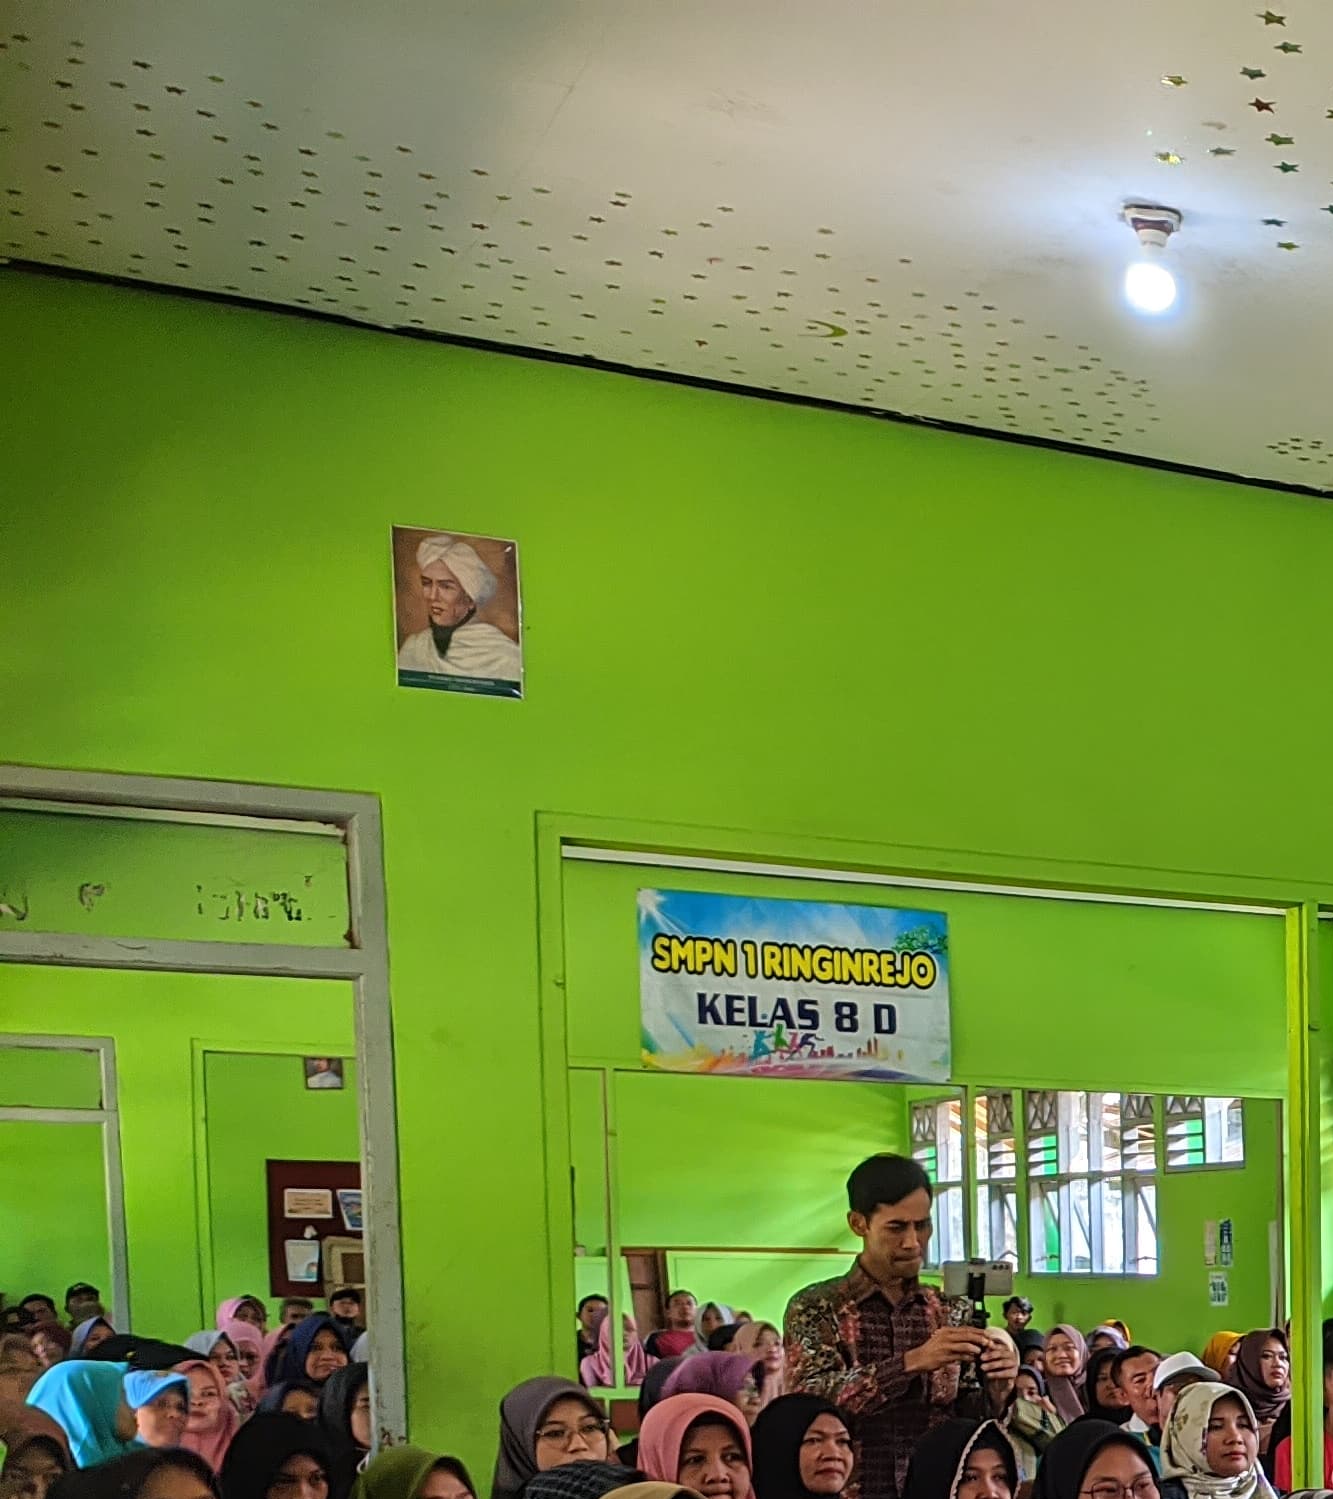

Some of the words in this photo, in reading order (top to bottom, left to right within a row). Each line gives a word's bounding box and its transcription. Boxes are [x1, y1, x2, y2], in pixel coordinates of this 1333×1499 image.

[652, 933, 737, 977] SMPN
[741, 940, 758, 979] 1
[761, 941, 939, 989] RINGINREJO
[697, 992, 820, 1031] KELAS
[834, 1001, 858, 1034] 8
[874, 1003, 897, 1034] D
